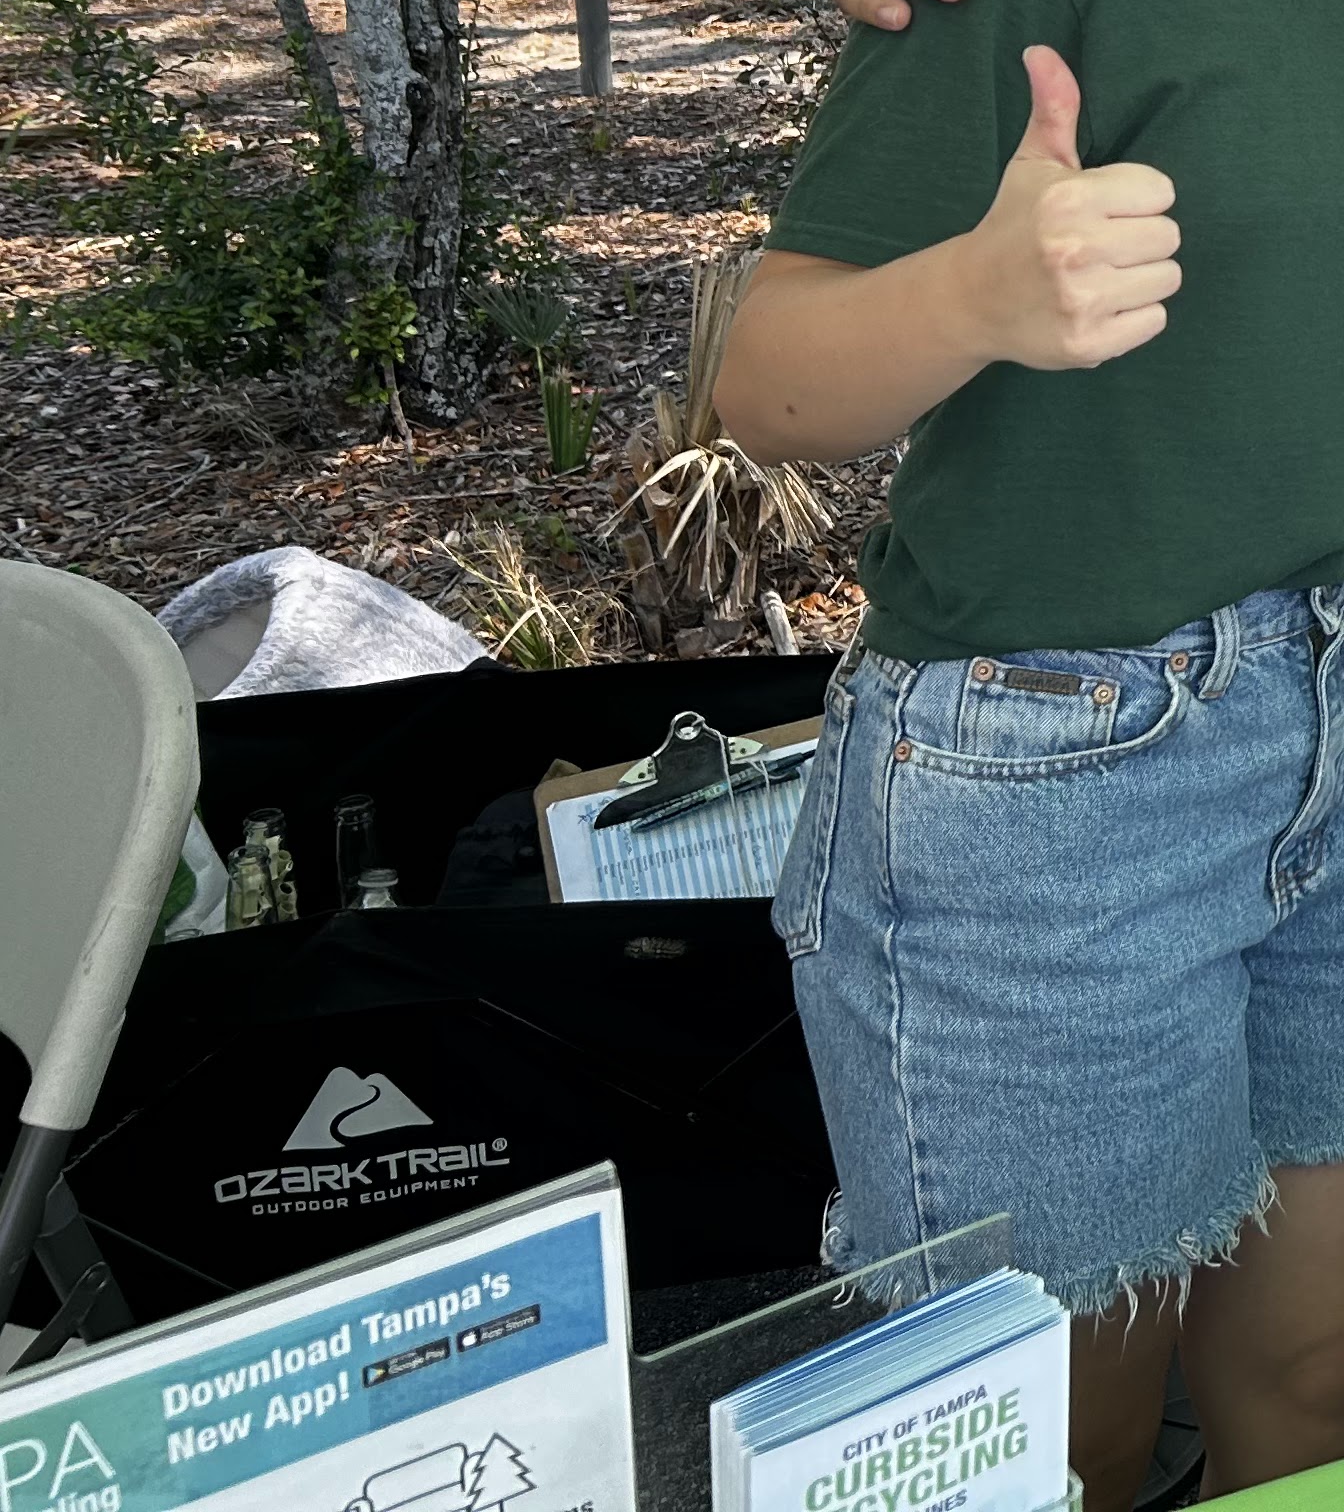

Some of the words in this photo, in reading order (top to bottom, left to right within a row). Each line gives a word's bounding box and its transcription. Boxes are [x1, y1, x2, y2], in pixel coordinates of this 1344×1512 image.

[252, 1197, 348, 1214] OUTDOOR
[359, 1175, 478, 1203] EQUIPMENT
[162, 1323, 351, 1419] Download
[360, 1272, 510, 1344] Tampa's
[167, 1411, 252, 1464] New
[264, 1370, 349, 1429] App!
[803, 1387, 1021, 1512] CURBSIDE
[842, 1429, 886, 1460] CITY
[893, 1416, 917, 1439] OF
[924, 1384, 987, 1424] TAMPA
